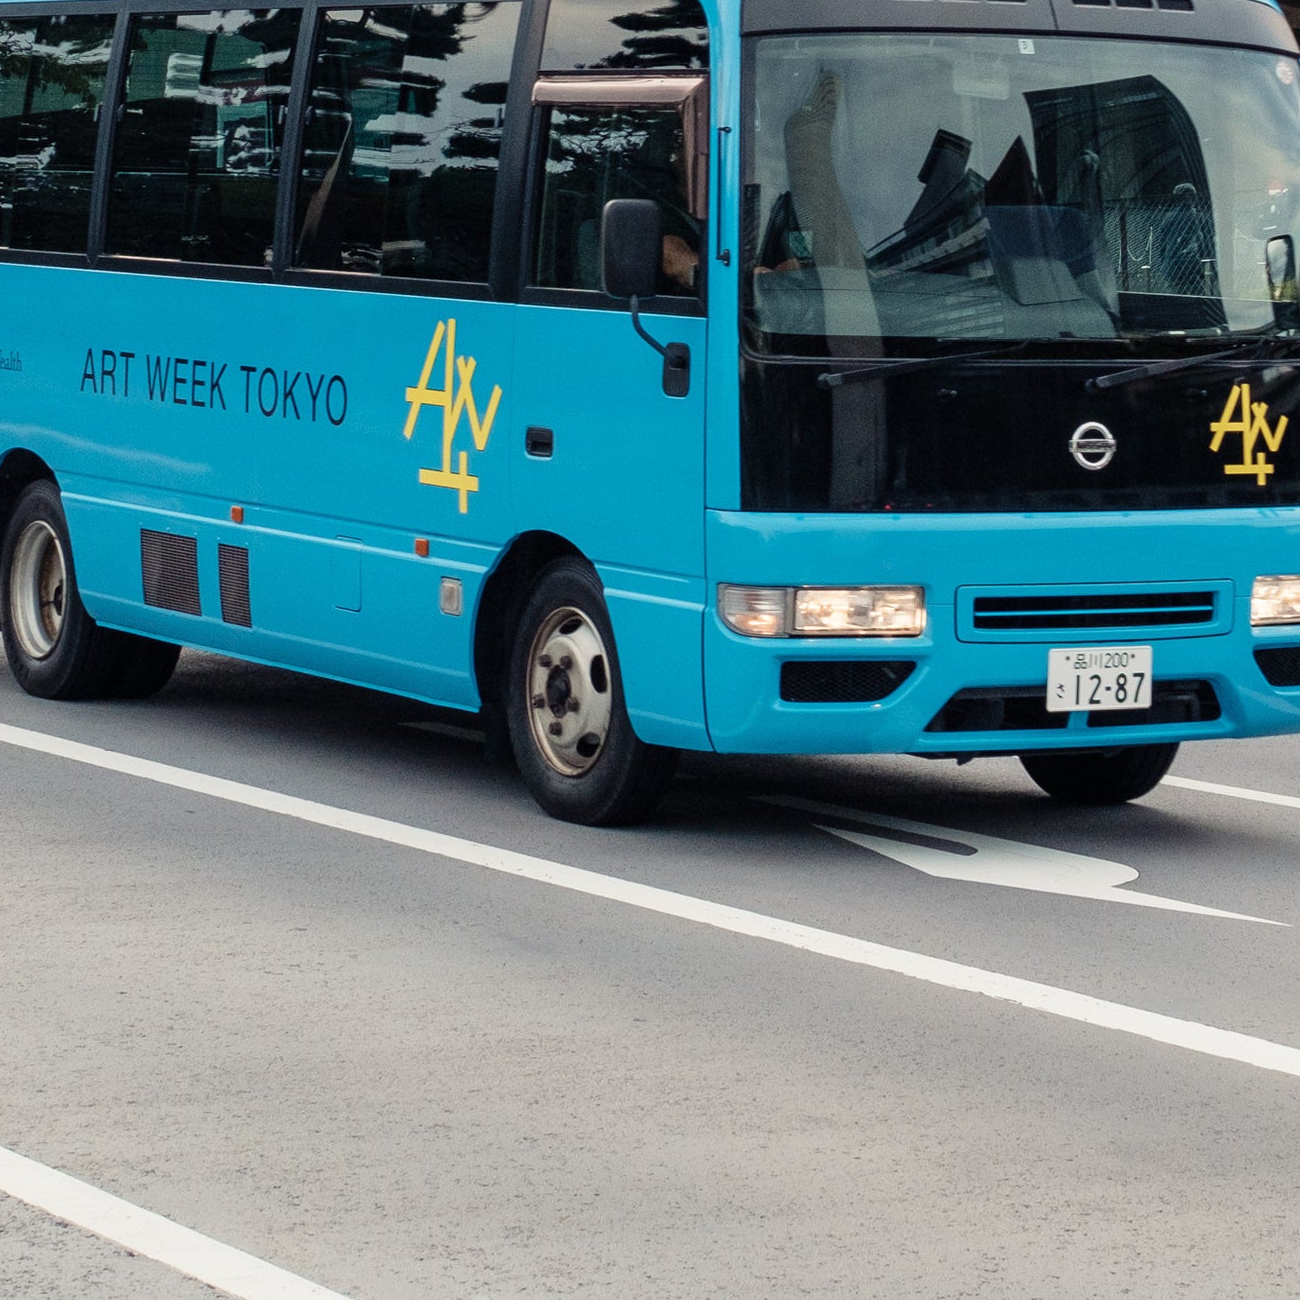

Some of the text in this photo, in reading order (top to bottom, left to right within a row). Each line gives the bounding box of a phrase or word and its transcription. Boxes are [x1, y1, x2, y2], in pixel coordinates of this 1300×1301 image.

[80, 348, 348, 426] ART WEEK TOKYO
[1075, 672, 1146, 706] 12-87
